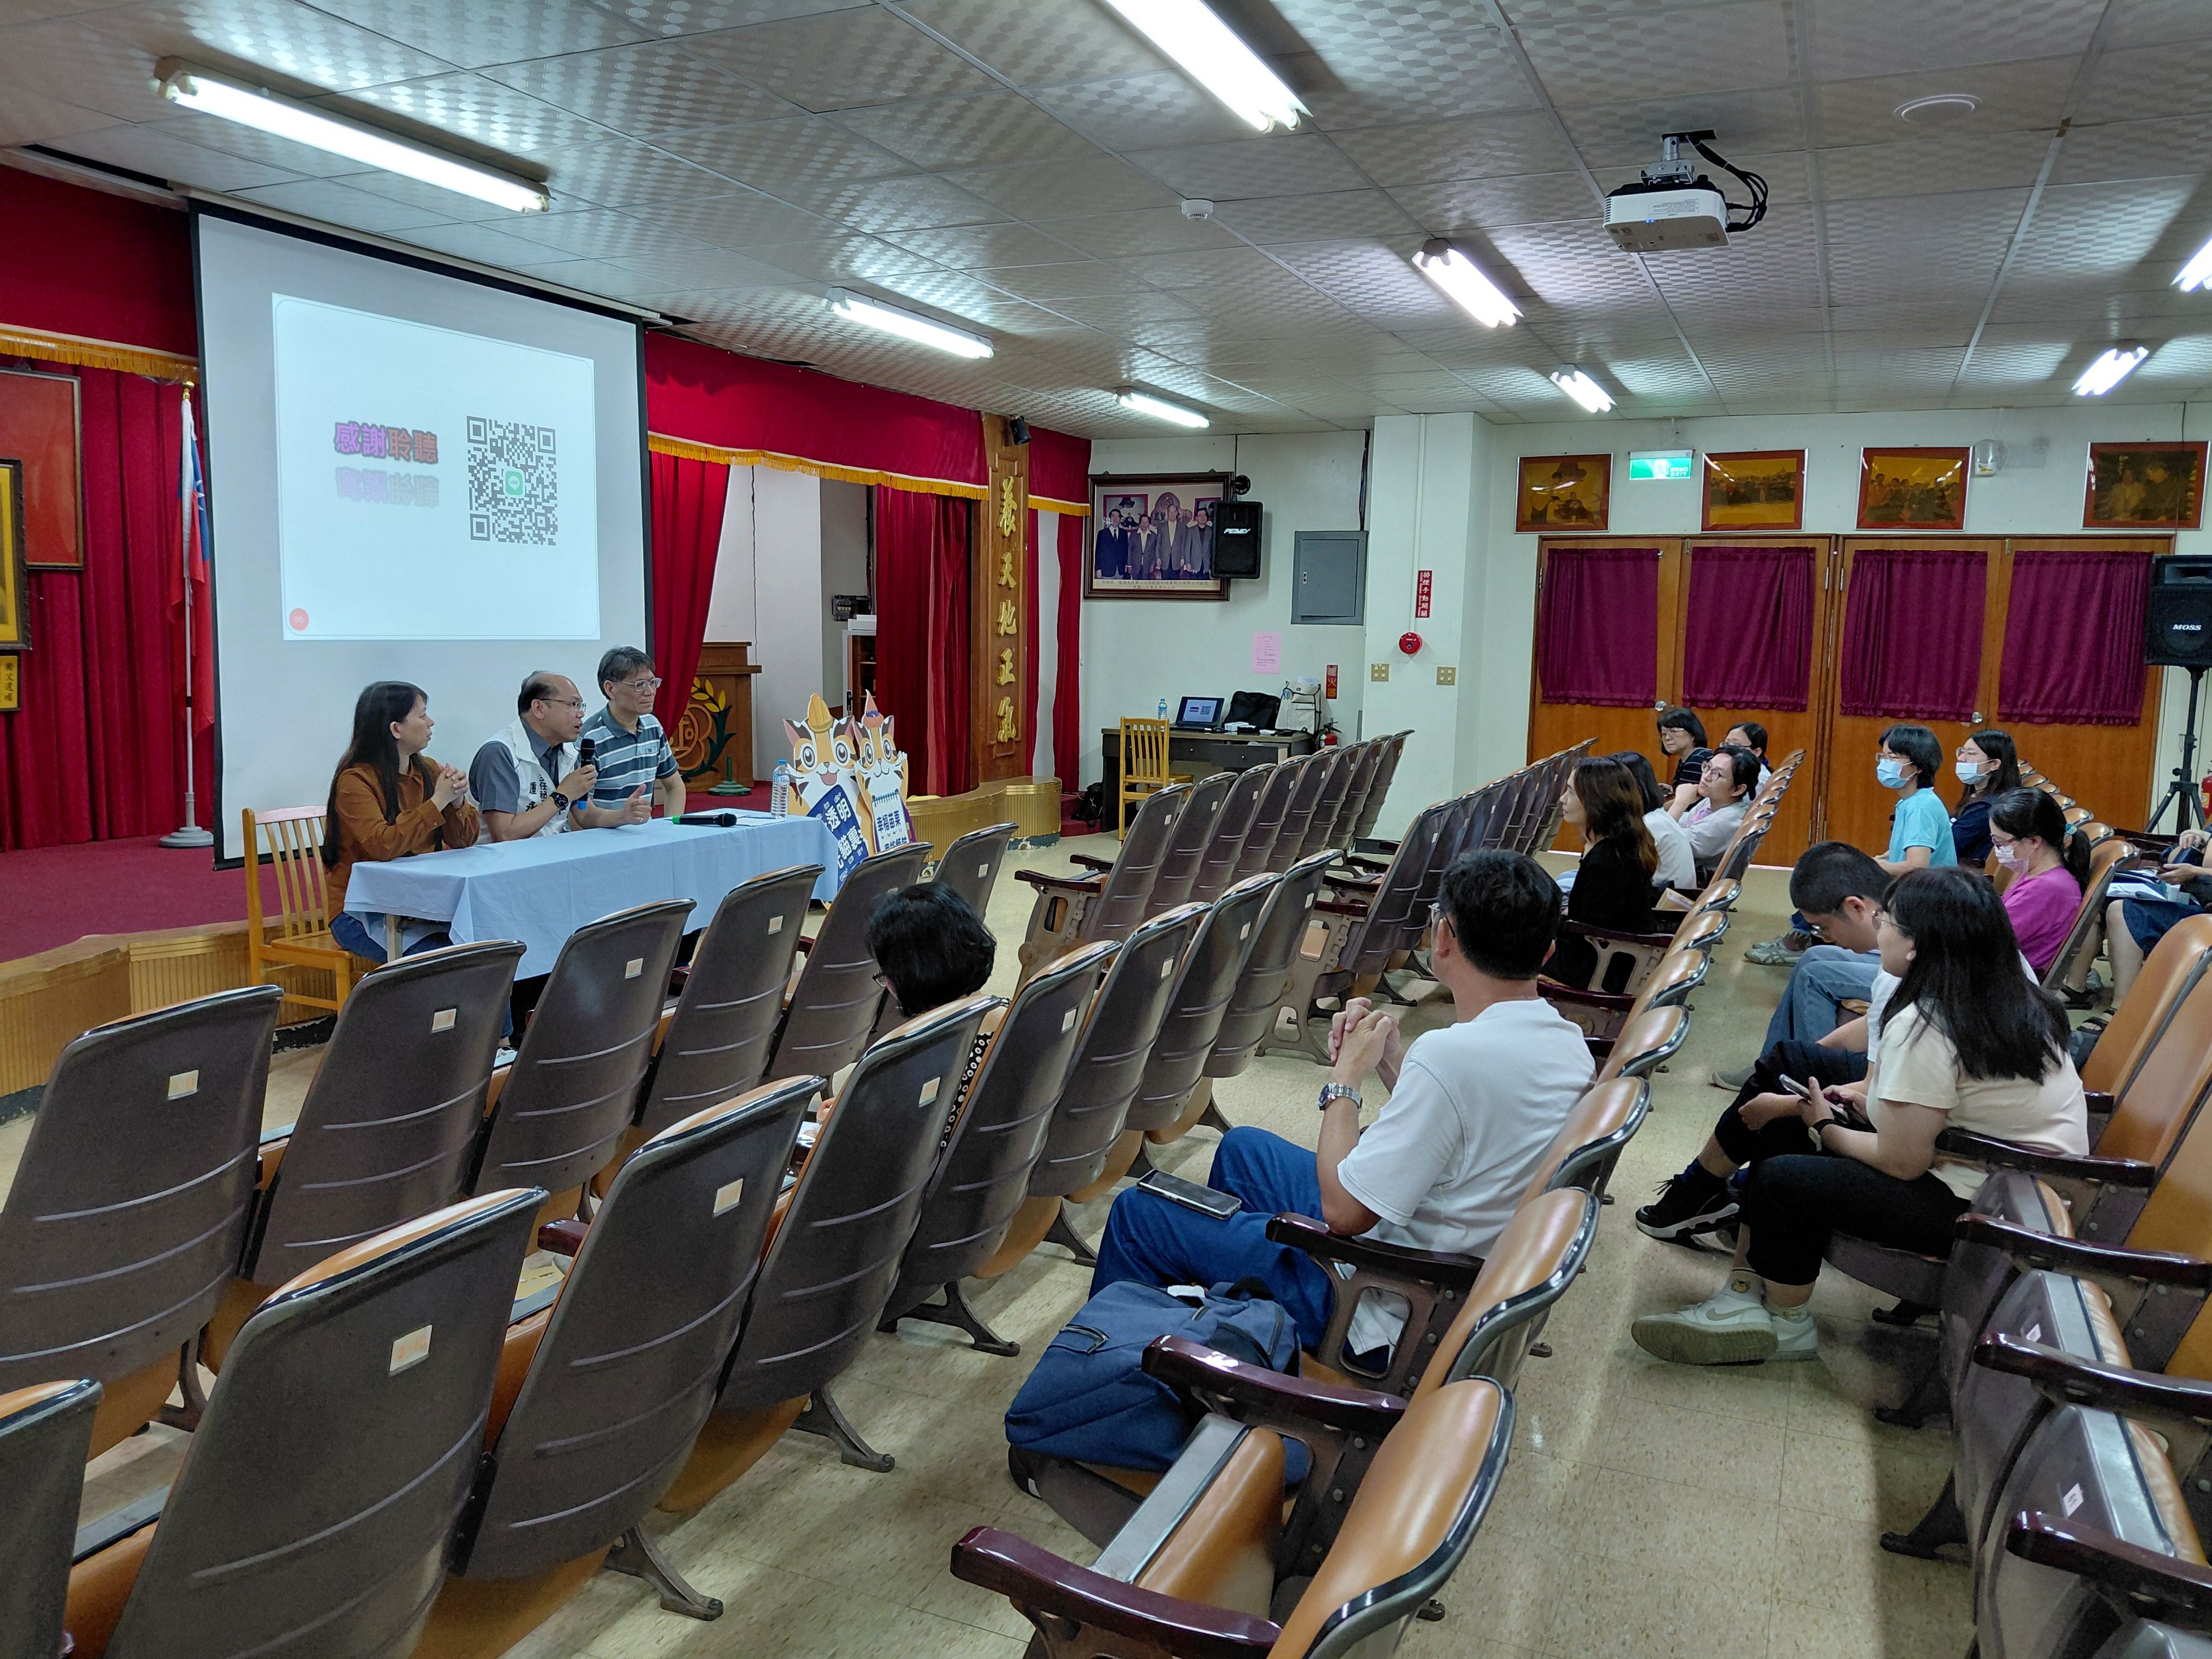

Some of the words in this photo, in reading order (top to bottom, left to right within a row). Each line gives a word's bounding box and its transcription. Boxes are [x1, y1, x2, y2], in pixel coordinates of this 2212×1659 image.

[334, 421, 439, 464] 感謝聆聽
[997, 476, 1018, 742] 養天地正氣
